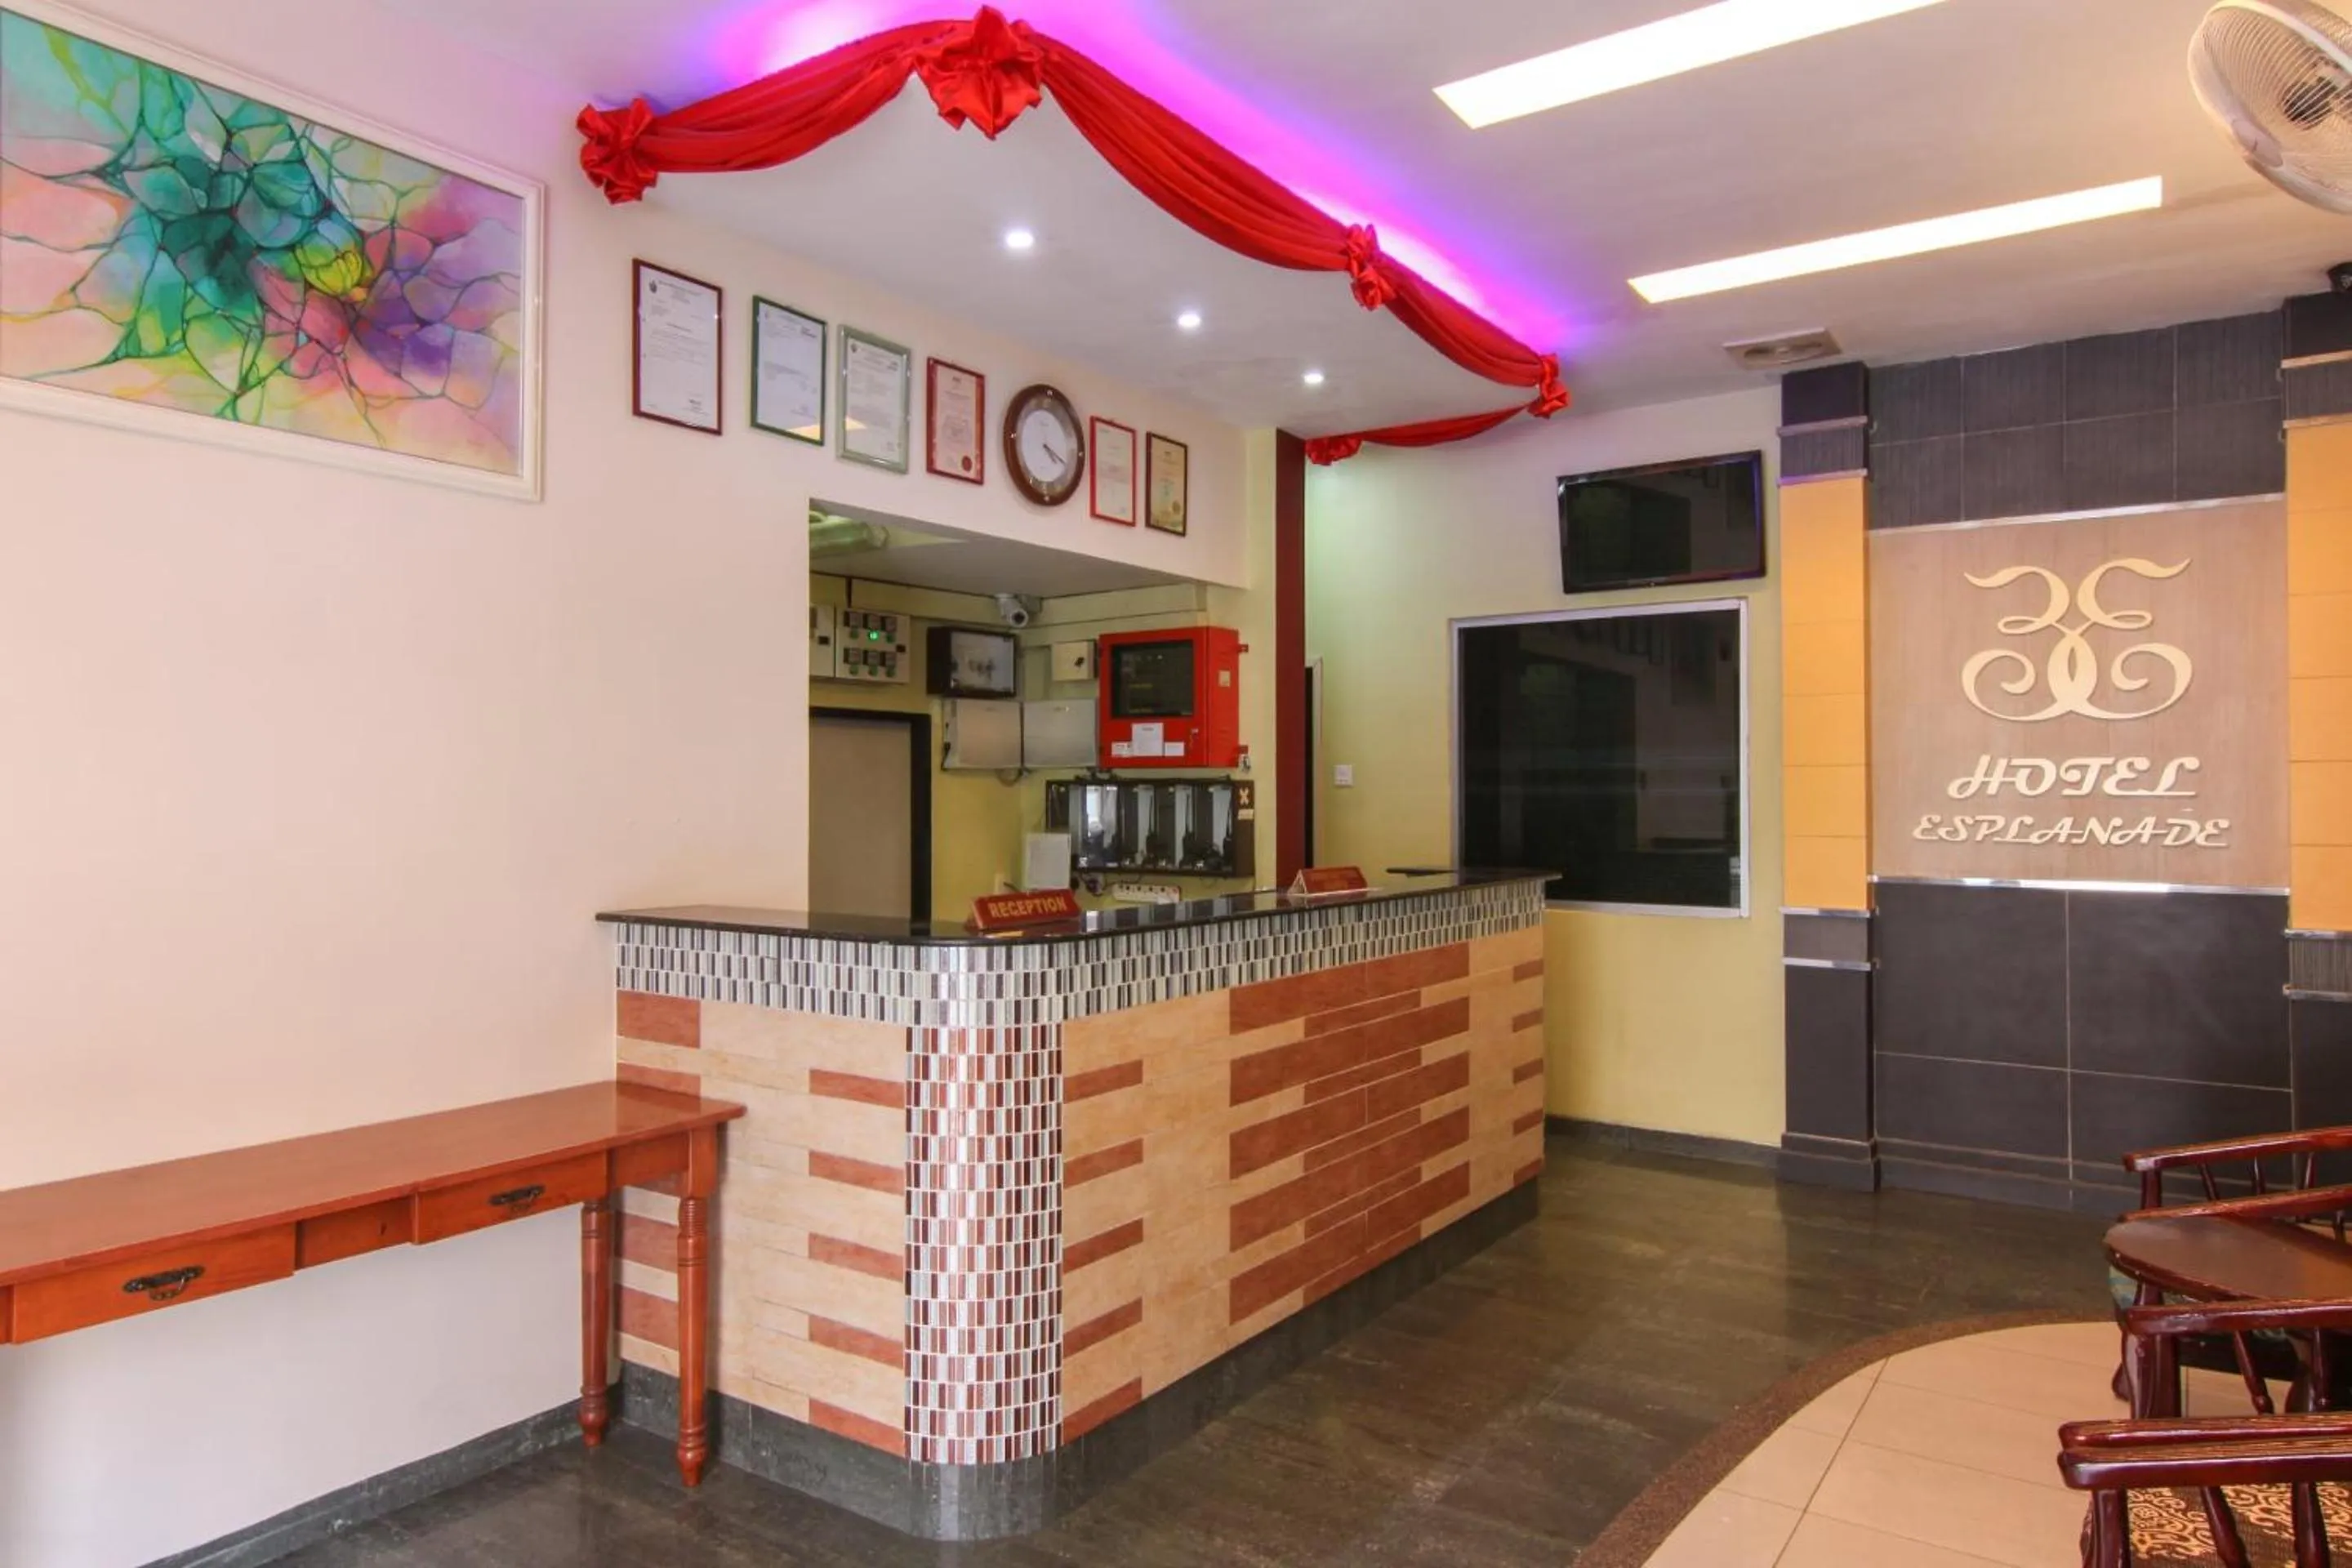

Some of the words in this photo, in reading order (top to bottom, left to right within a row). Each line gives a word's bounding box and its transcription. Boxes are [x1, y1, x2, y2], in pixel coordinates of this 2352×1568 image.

[1947, 754, 2200, 799] HOTEL
[1912, 814, 2230, 847] ESPLANADE
[988, 897, 1067, 918] RECEPTION
